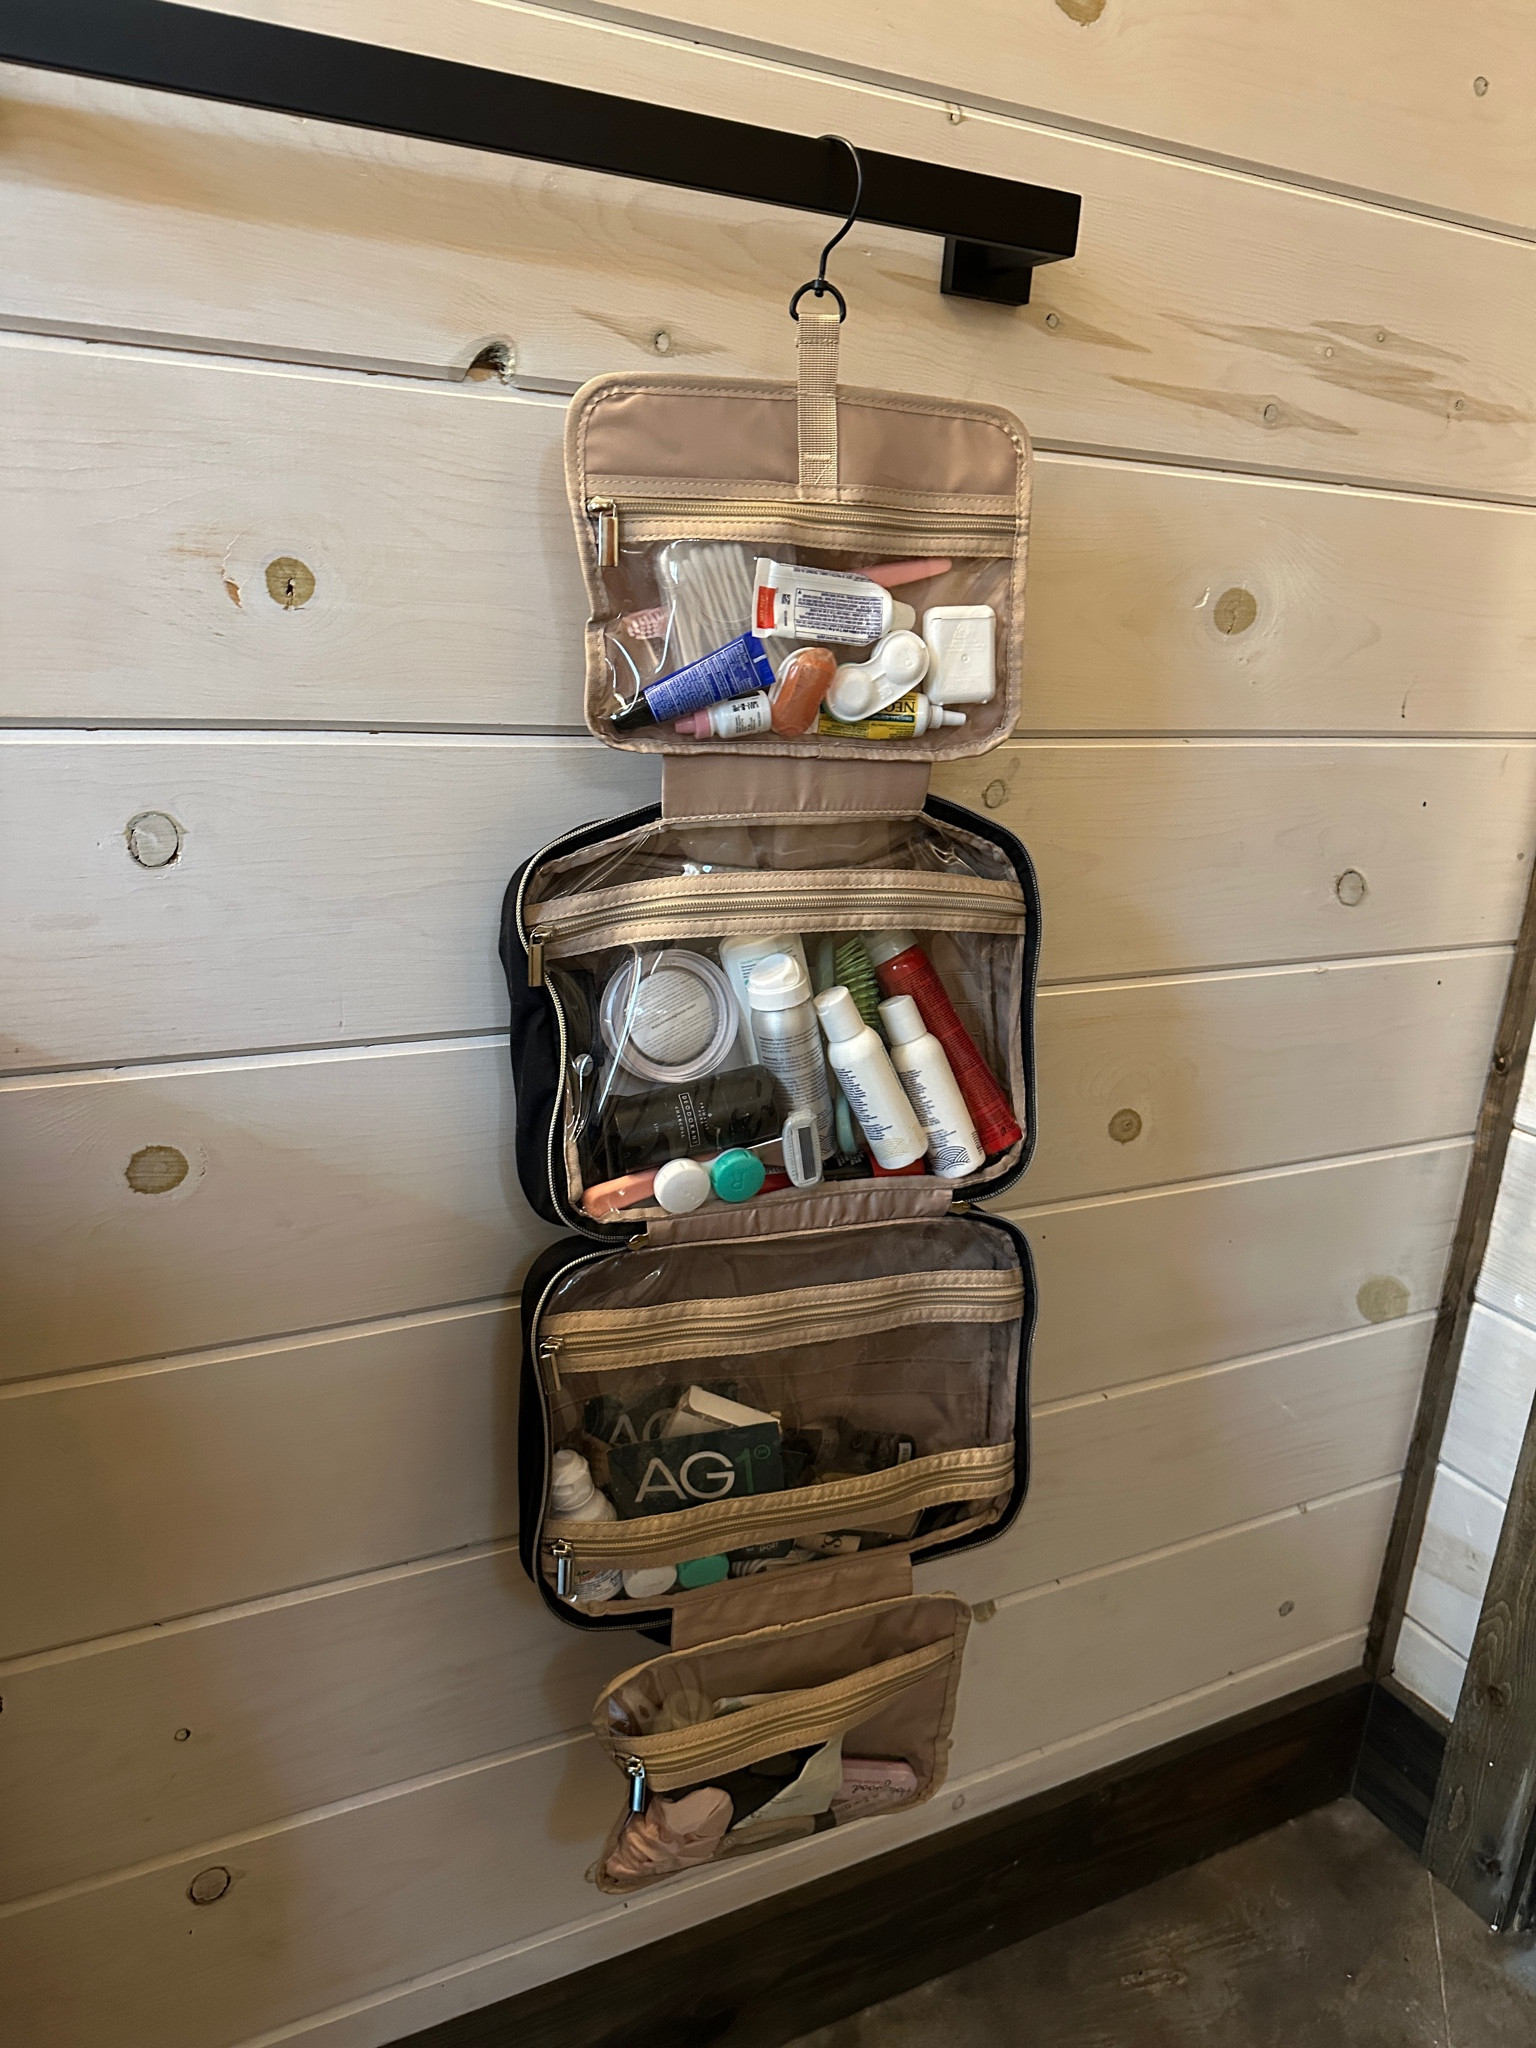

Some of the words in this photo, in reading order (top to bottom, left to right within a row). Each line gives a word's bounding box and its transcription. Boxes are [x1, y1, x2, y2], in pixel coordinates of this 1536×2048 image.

[883, 701, 916, 714] NEO
[675, 1106, 685, 1138] CHARCOAL
[682, 1095, 698, 1144] DEODORANT
[635, 1447, 754, 1503] AG1
